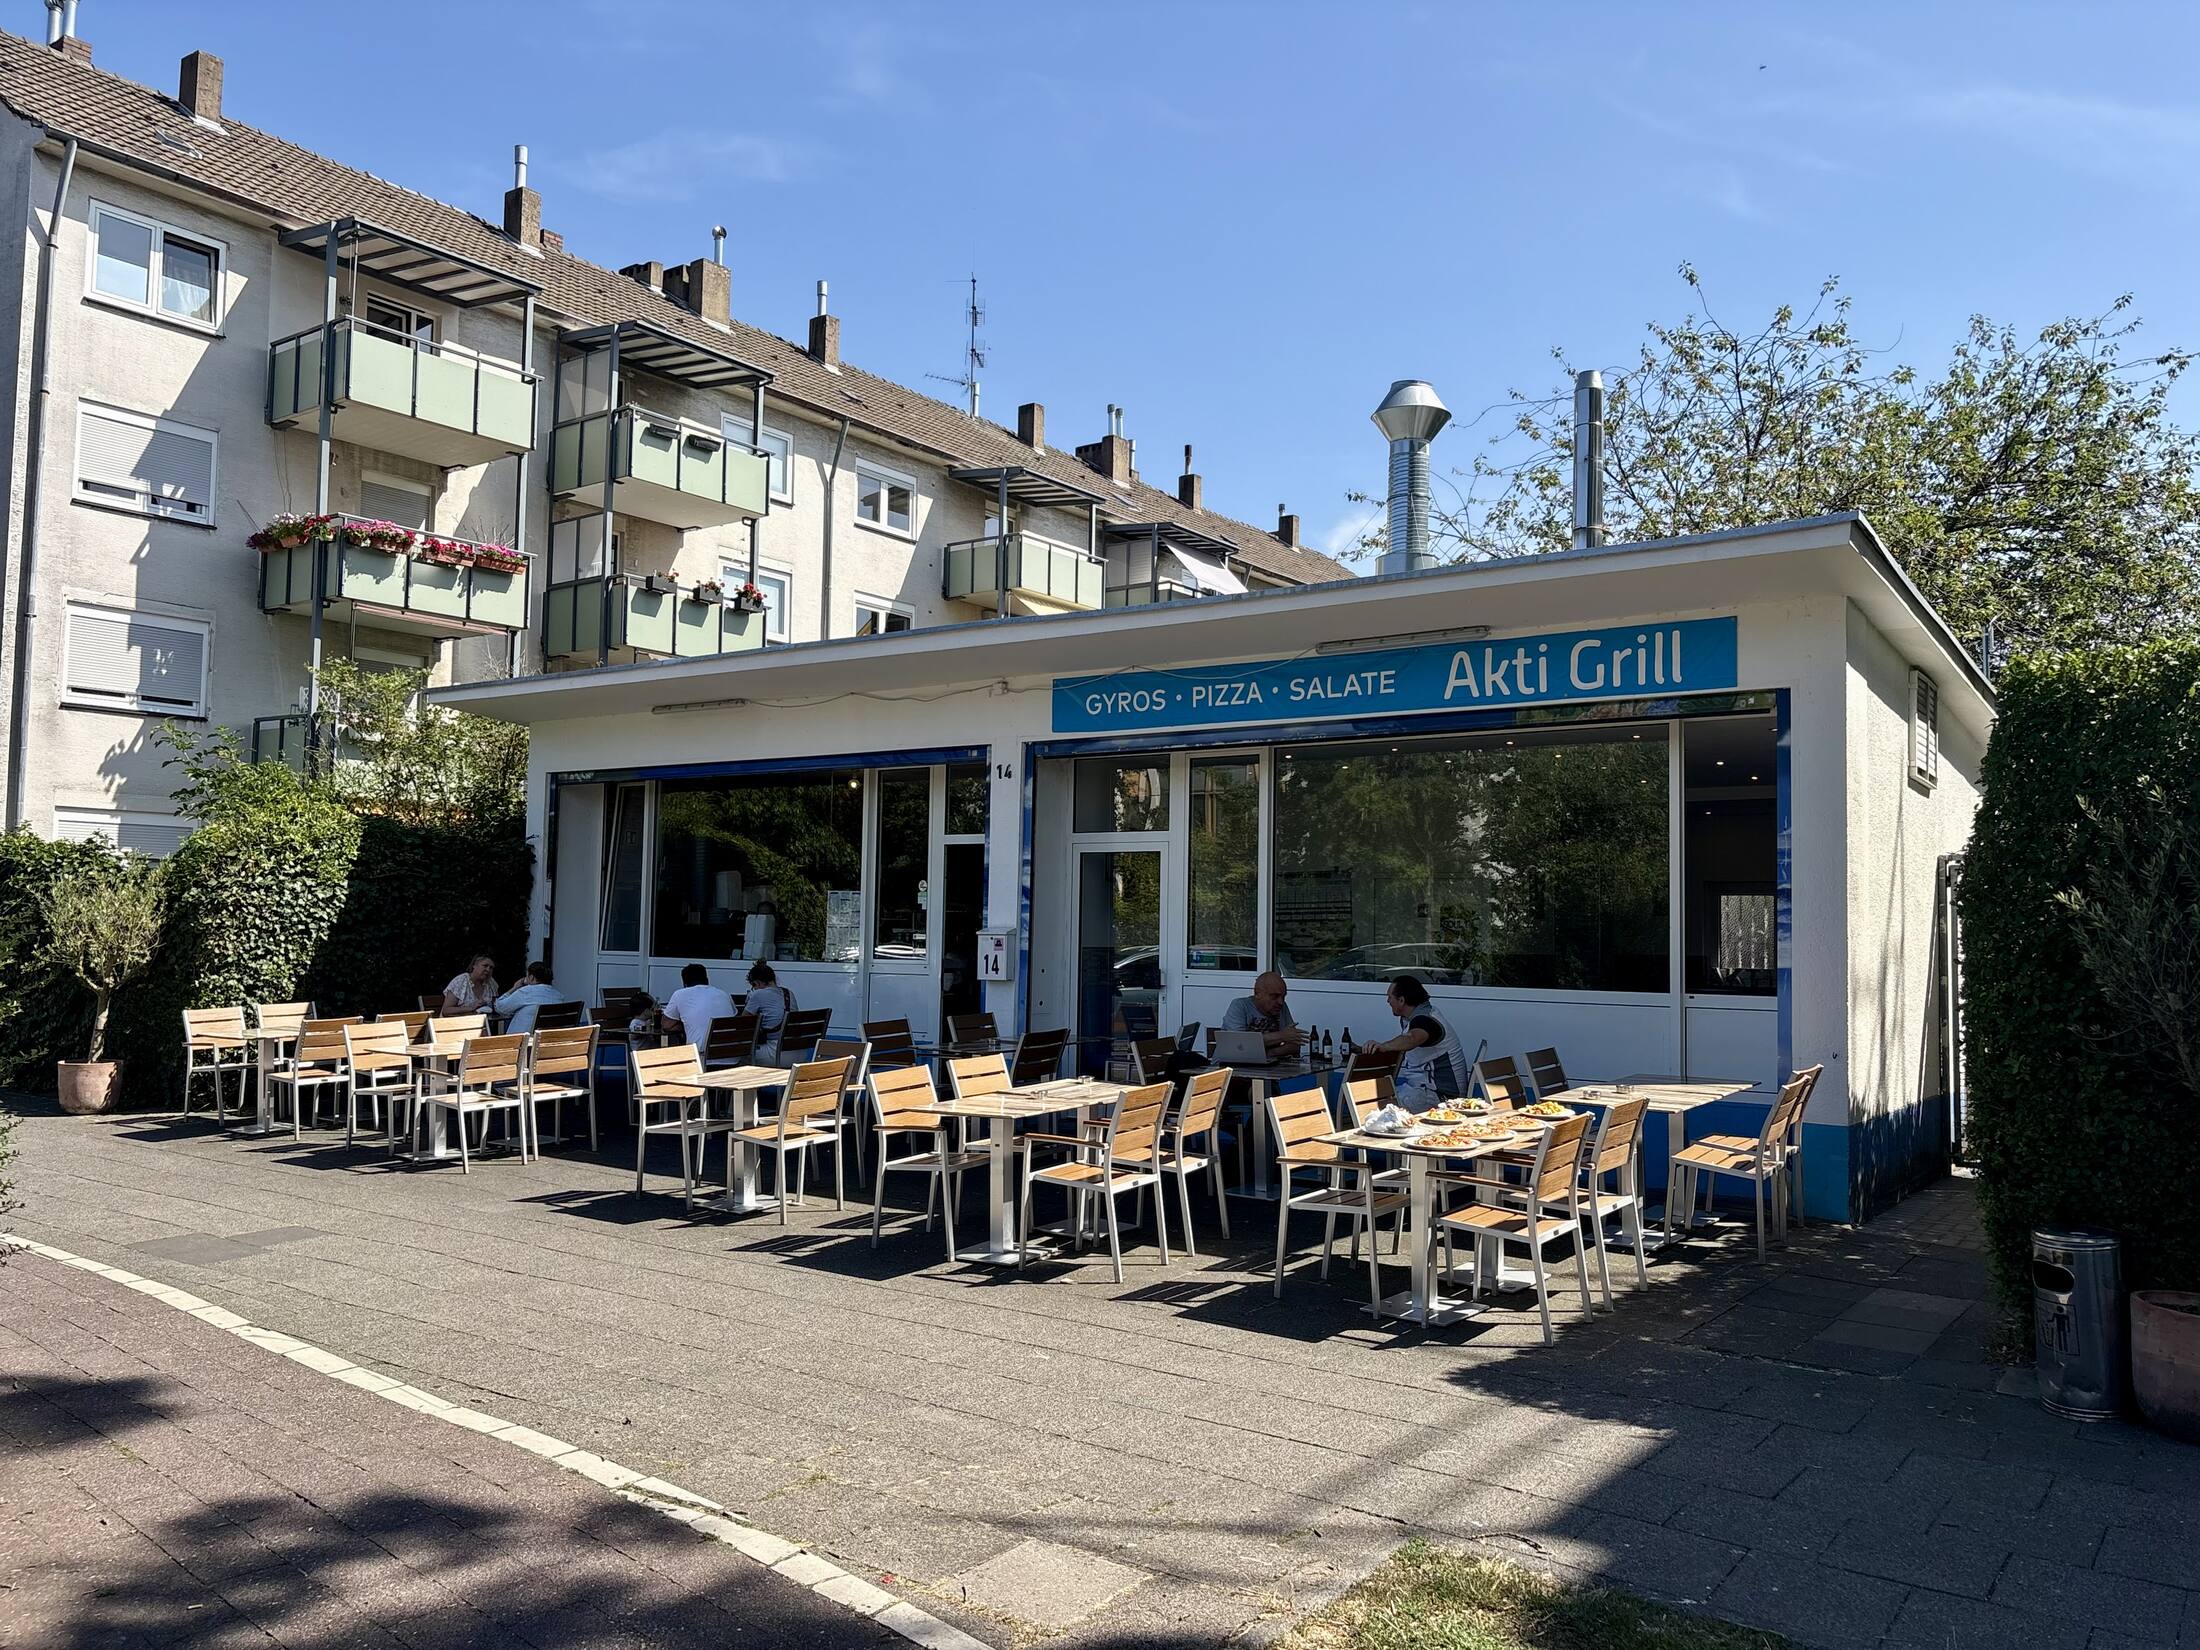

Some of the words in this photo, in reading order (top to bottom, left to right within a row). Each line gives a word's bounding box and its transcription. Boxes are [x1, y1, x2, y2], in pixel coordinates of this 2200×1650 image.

[1443, 643, 1549, 700] Akti
[1568, 629, 1683, 691] Grill
[1086, 688, 1166, 716] GYROS
[1191, 682, 1263, 709] PIZZA
[1289, 669, 1396, 702] SALATE
[996, 763, 1013, 781] 14
[983, 953, 1000, 975] 14
